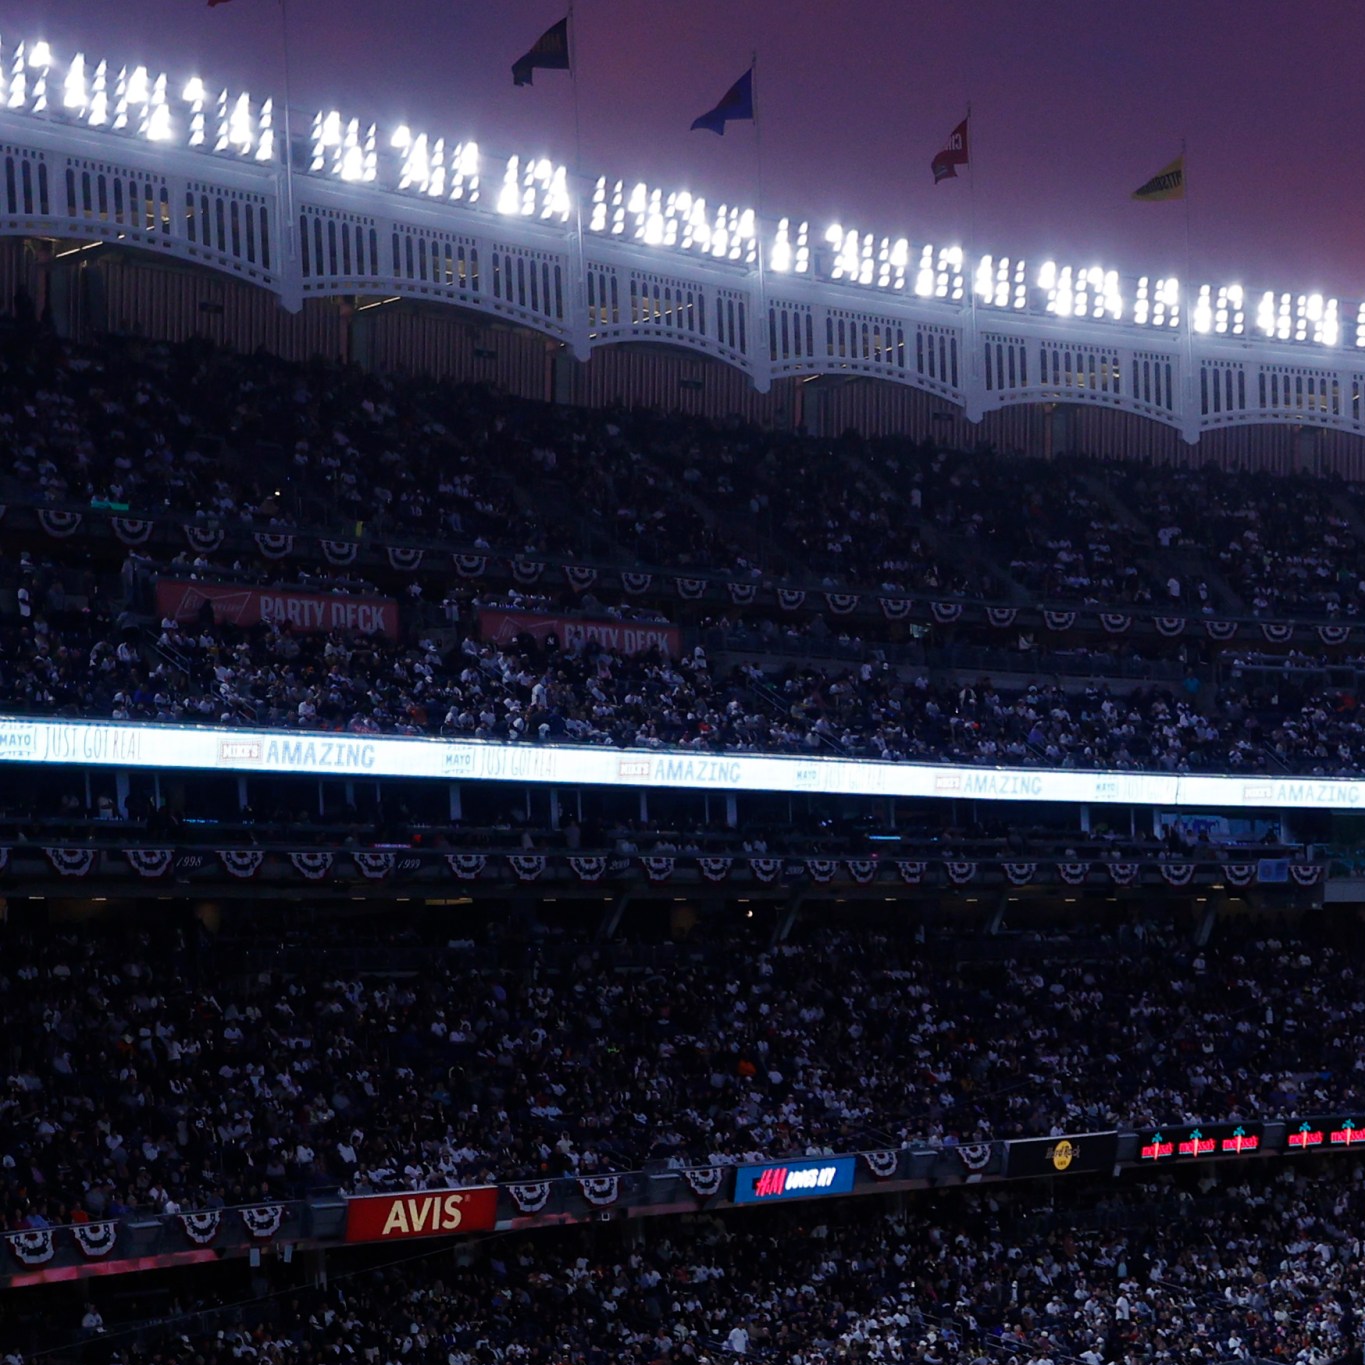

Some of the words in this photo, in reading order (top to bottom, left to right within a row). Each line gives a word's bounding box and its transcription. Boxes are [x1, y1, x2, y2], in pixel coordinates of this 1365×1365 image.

[259, 596, 325, 629] PARTY
[331, 602, 386, 634] DECK
[266, 740, 376, 768] AMAZING
[654, 760, 741, 784] AMAZING
[382, 1195, 463, 1235] AVIS
